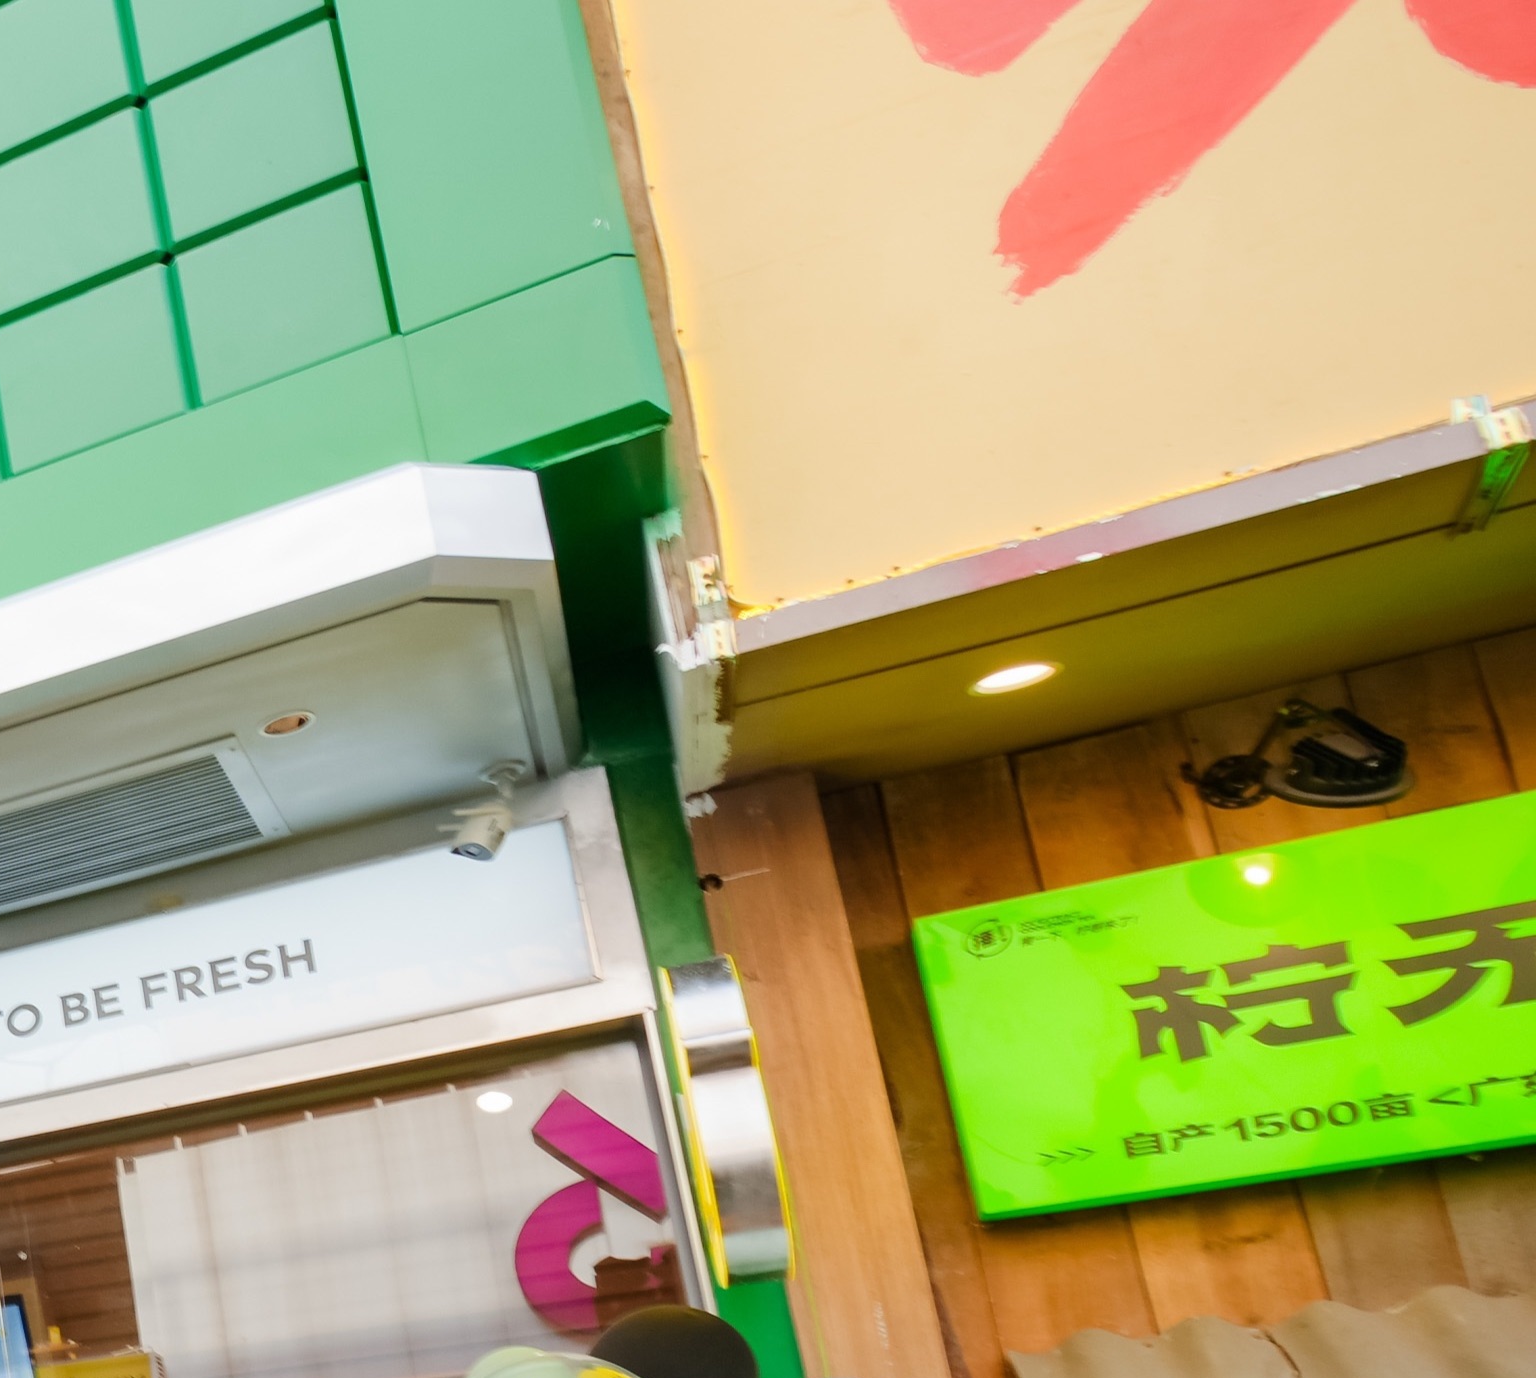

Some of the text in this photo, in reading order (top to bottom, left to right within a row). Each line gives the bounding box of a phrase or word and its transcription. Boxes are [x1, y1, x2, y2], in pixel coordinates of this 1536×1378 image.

[60, 982, 125, 1028] BE
[140, 938, 318, 1010] FRESH
[1122, 1092, 1416, 1159] 自产1500亩
